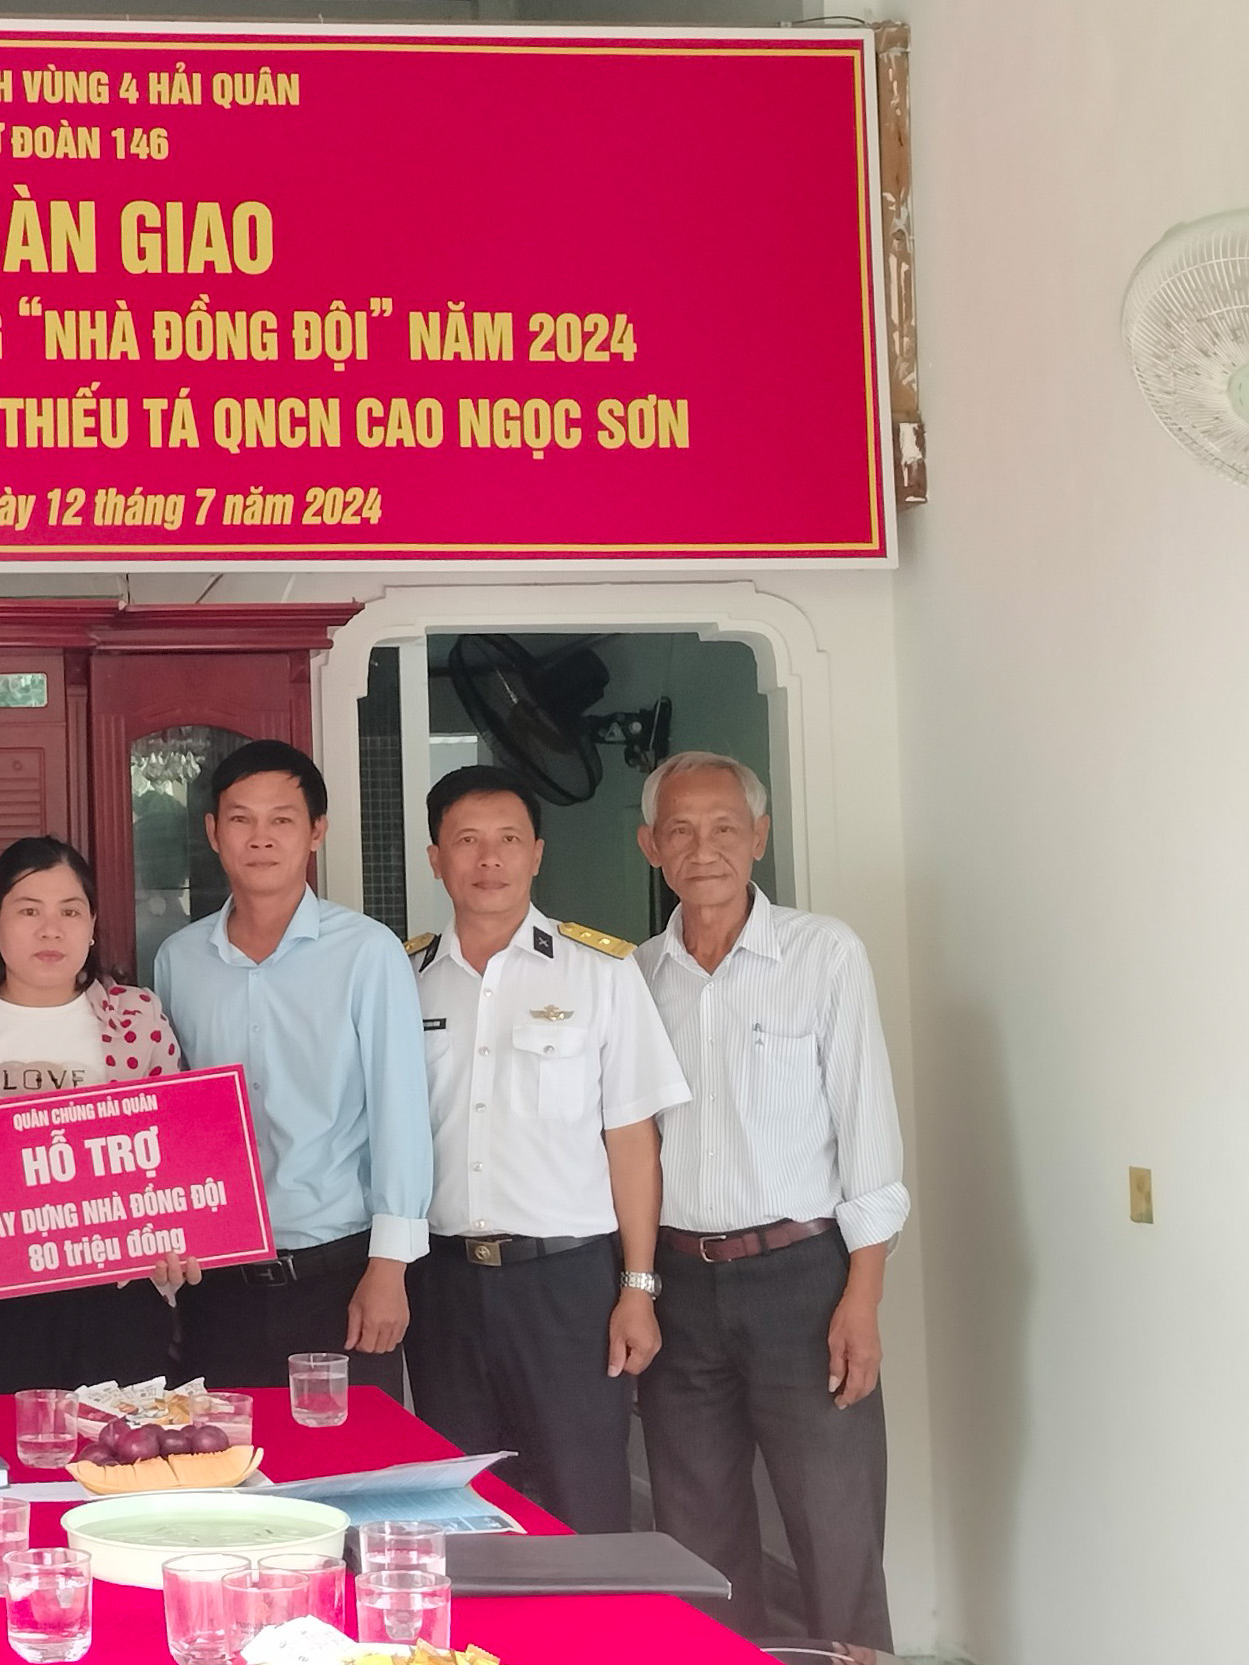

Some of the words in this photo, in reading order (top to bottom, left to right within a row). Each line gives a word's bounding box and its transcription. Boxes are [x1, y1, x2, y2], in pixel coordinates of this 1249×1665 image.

[23, 65, 109, 103] VÙNG
[120, 73, 138, 103] 4
[149, 62, 201, 104] HẢI
[213, 67, 299, 108] QUÂN
[11, 120, 100, 158] ĐOÀN
[112, 128, 168, 159] 146
[121, 201, 273, 274] GIAO
[19, 297, 139, 360] “NHÀ
[153, 294, 278, 360] ĐỒNG
[293, 298, 392, 371] ĐỘI”
[410, 302, 513, 360] NĂM
[529, 313, 636, 361] 2024
[0, 382, 128, 448] THIẾU
[143, 388, 199, 447] TÁ
[214, 398, 340, 453] QNCN
[357, 398, 443, 447] CAO
[459, 399, 581, 459] NGỌC
[598, 395, 689, 448] SƠN
[48, 488, 85, 525] 12
[94, 487, 185, 530] tháng
[196, 489, 216, 525] 7
[223, 487, 293, 524] năm
[302, 487, 381, 524] 2024
[3, 1069, 85, 1090] LOVE
[13, 1109, 49, 1131] QUÂN
[51, 1101, 95, 1124] CHỦNG
[97, 1096, 120, 1119] HẢI
[122, 1093, 158, 1116] QUÂN
[21, 1129, 76, 1186] HỖ
[84, 1125, 161, 1178] TRỢ
[21, 1202, 79, 1237] DỰNG
[82, 1191, 127, 1225] NHÀ
[130, 1183, 187, 1218] ĐỒNG
[190, 1177, 227, 1213] ĐỘI
[28, 1242, 59, 1272] 80
[64, 1234, 121, 1269] triệu
[127, 1223, 187, 1258] đồng
